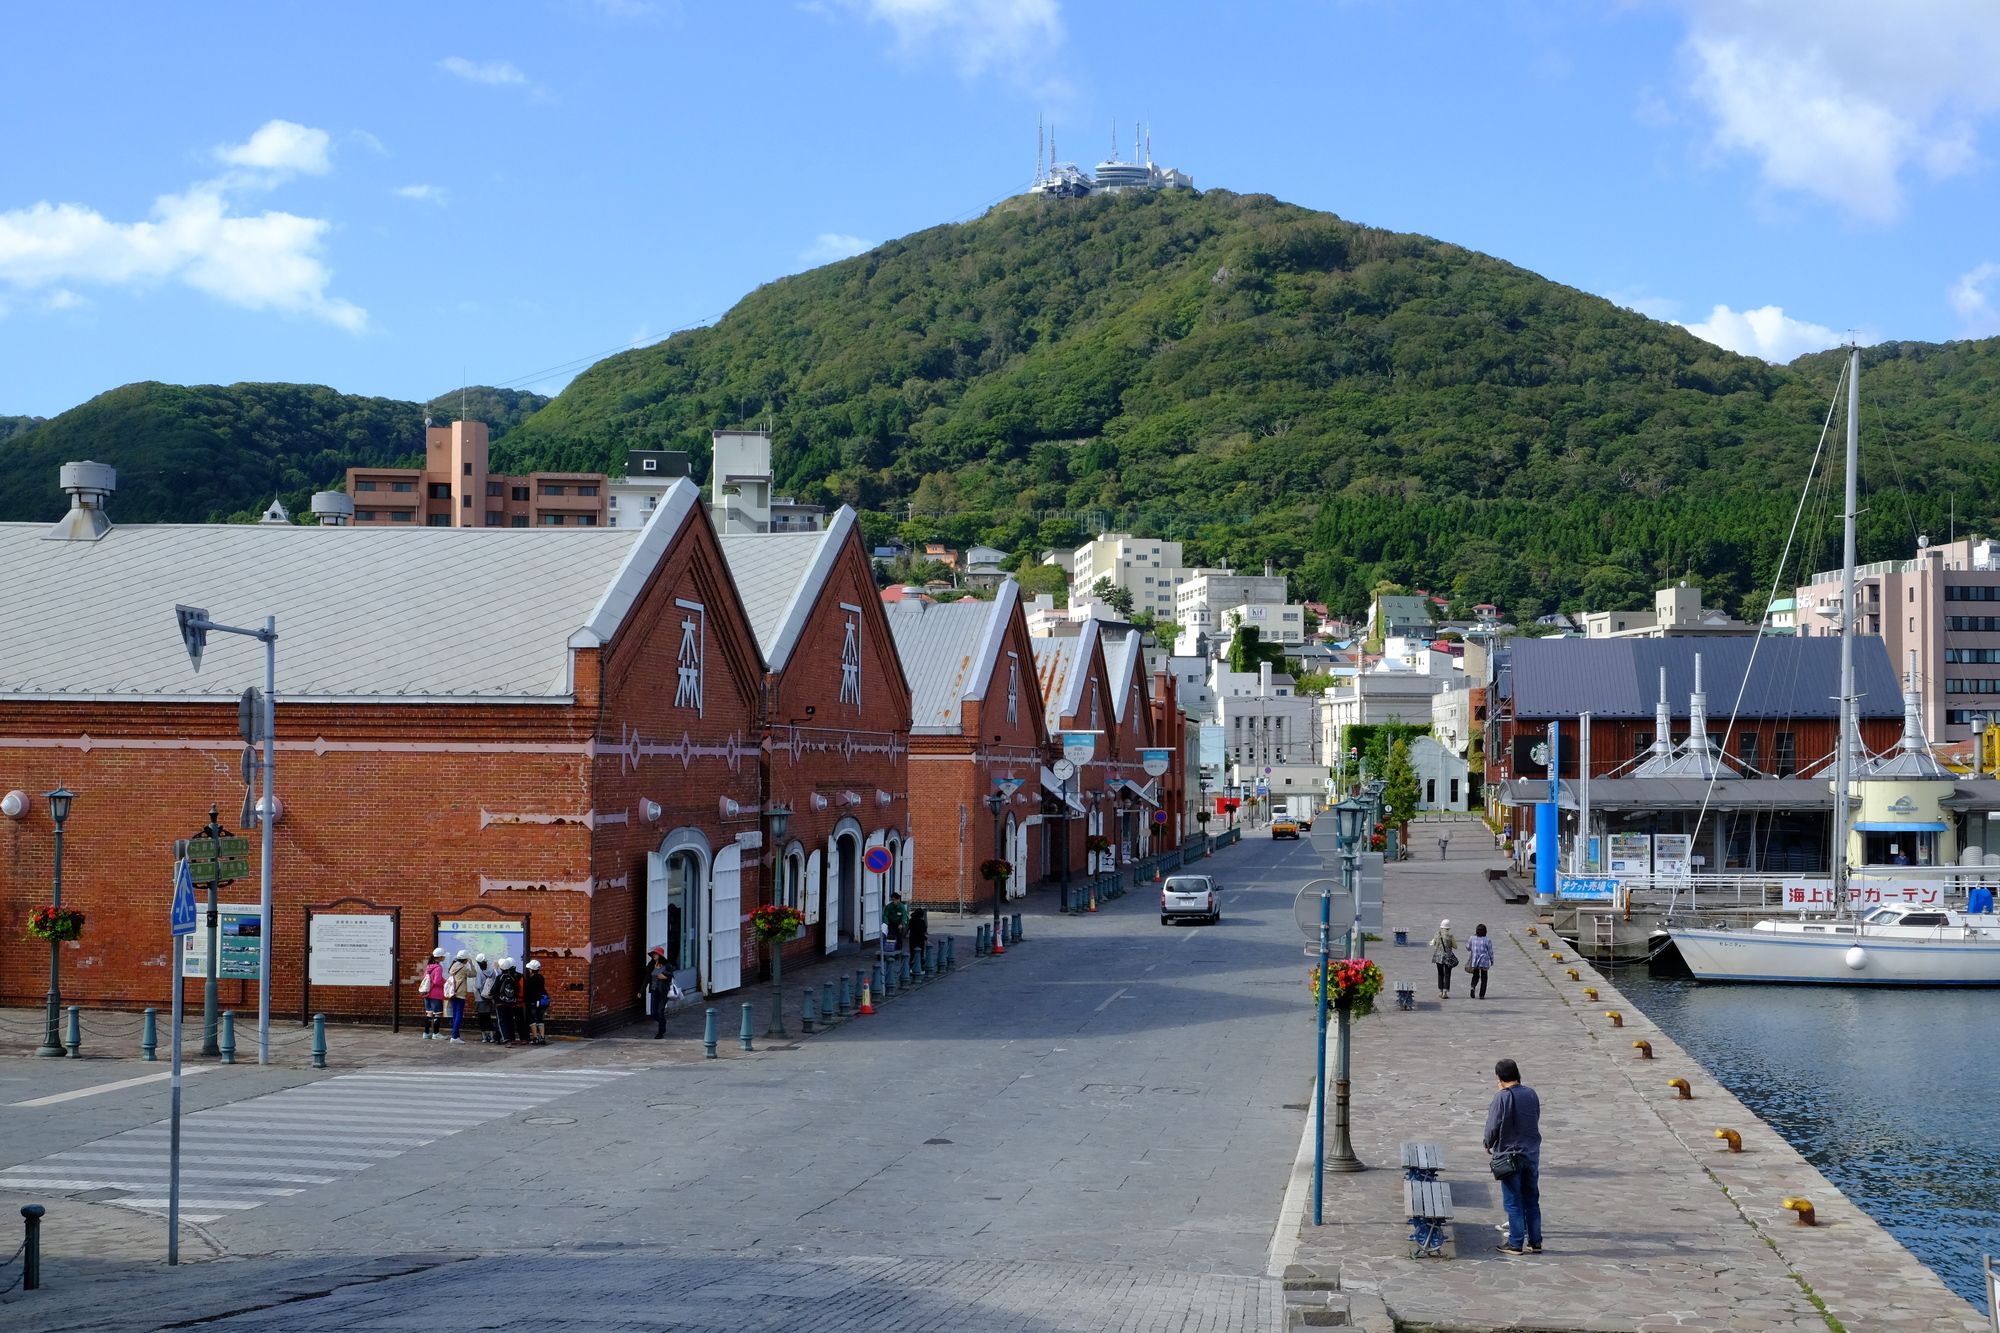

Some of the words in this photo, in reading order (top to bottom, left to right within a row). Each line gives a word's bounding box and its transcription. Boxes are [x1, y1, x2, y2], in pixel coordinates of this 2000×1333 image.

[1797, 593, 1816, 609] SEC
[1562, 881, 1607, 892] チケット売場
